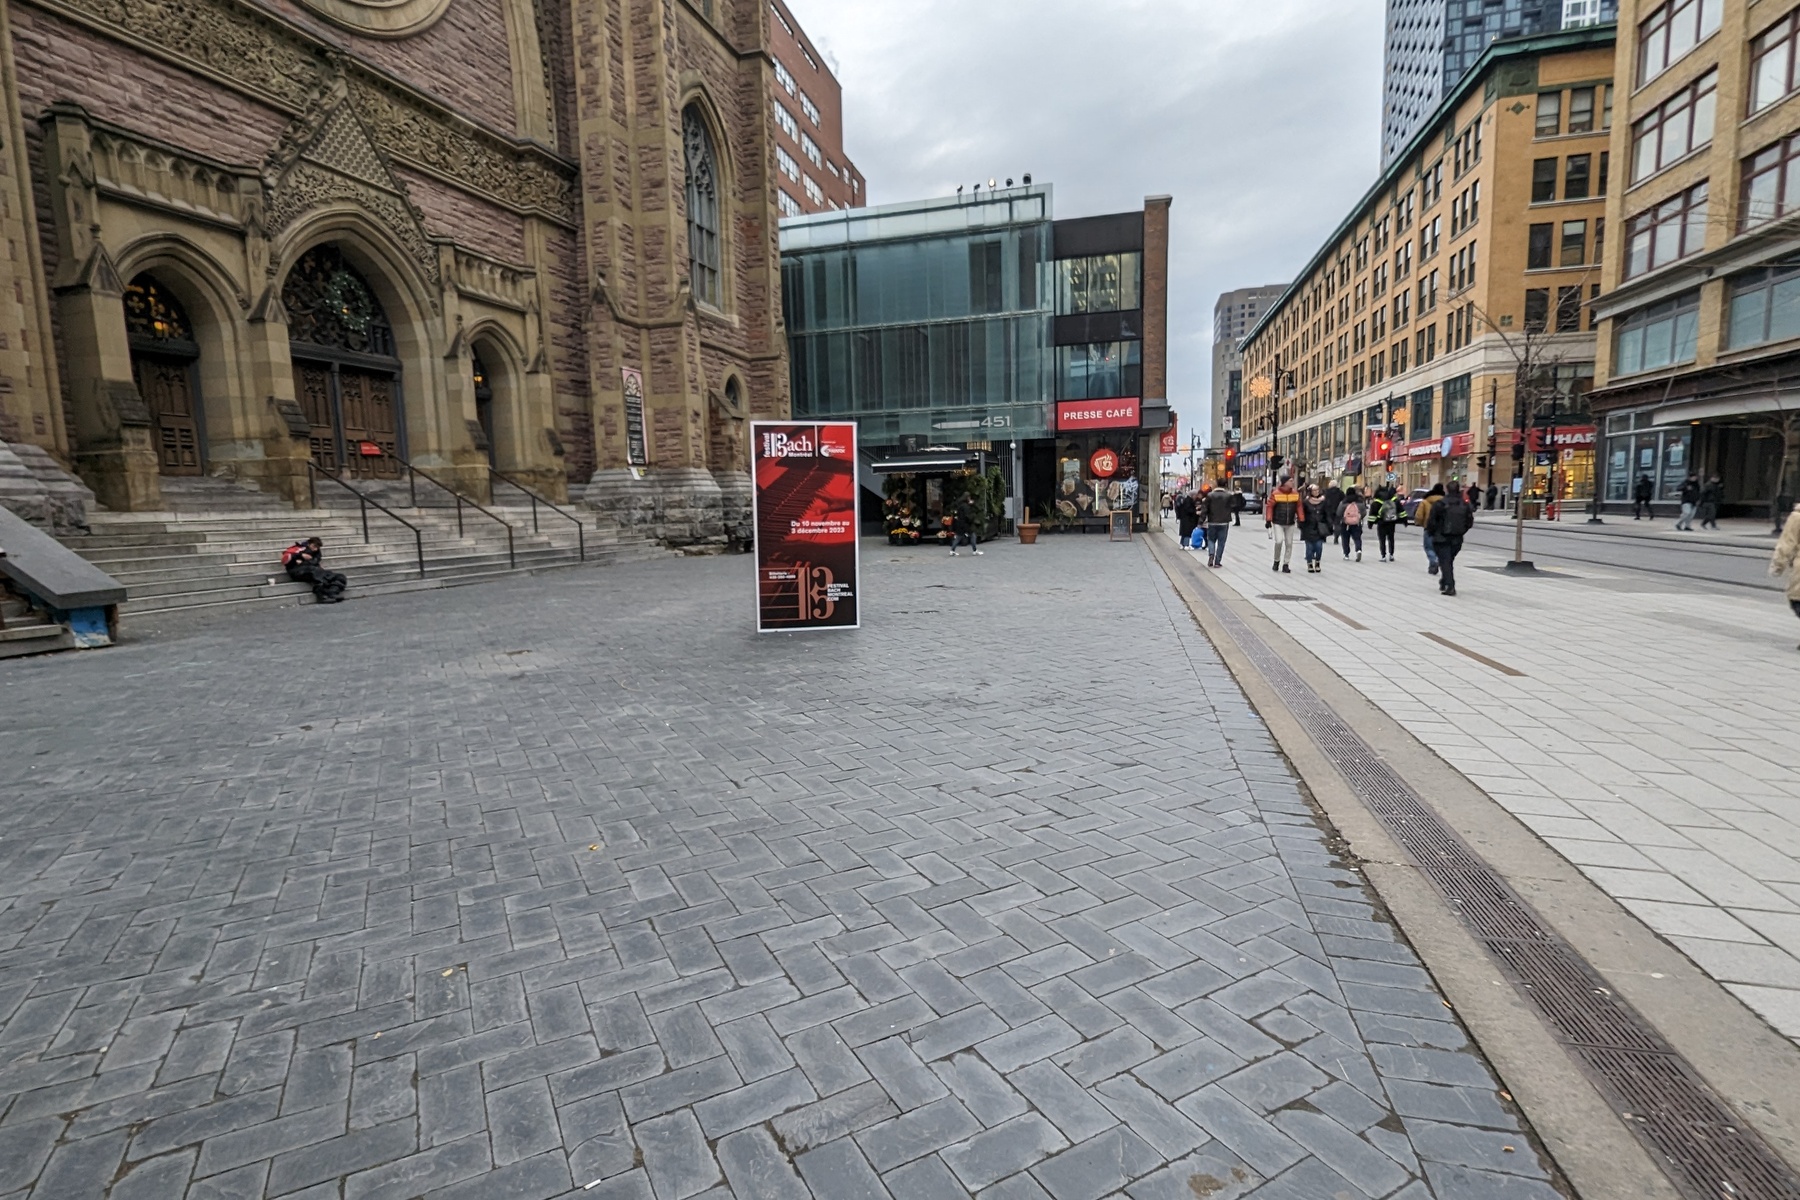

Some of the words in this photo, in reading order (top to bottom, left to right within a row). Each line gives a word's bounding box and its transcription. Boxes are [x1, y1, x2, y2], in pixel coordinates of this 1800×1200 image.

[1063, 410, 1103, 420] PRESSE
[1106, 406, 1133, 418] CAFÉ
[981, 416, 1010, 427] 451
[771, 433, 812, 457] Bach
